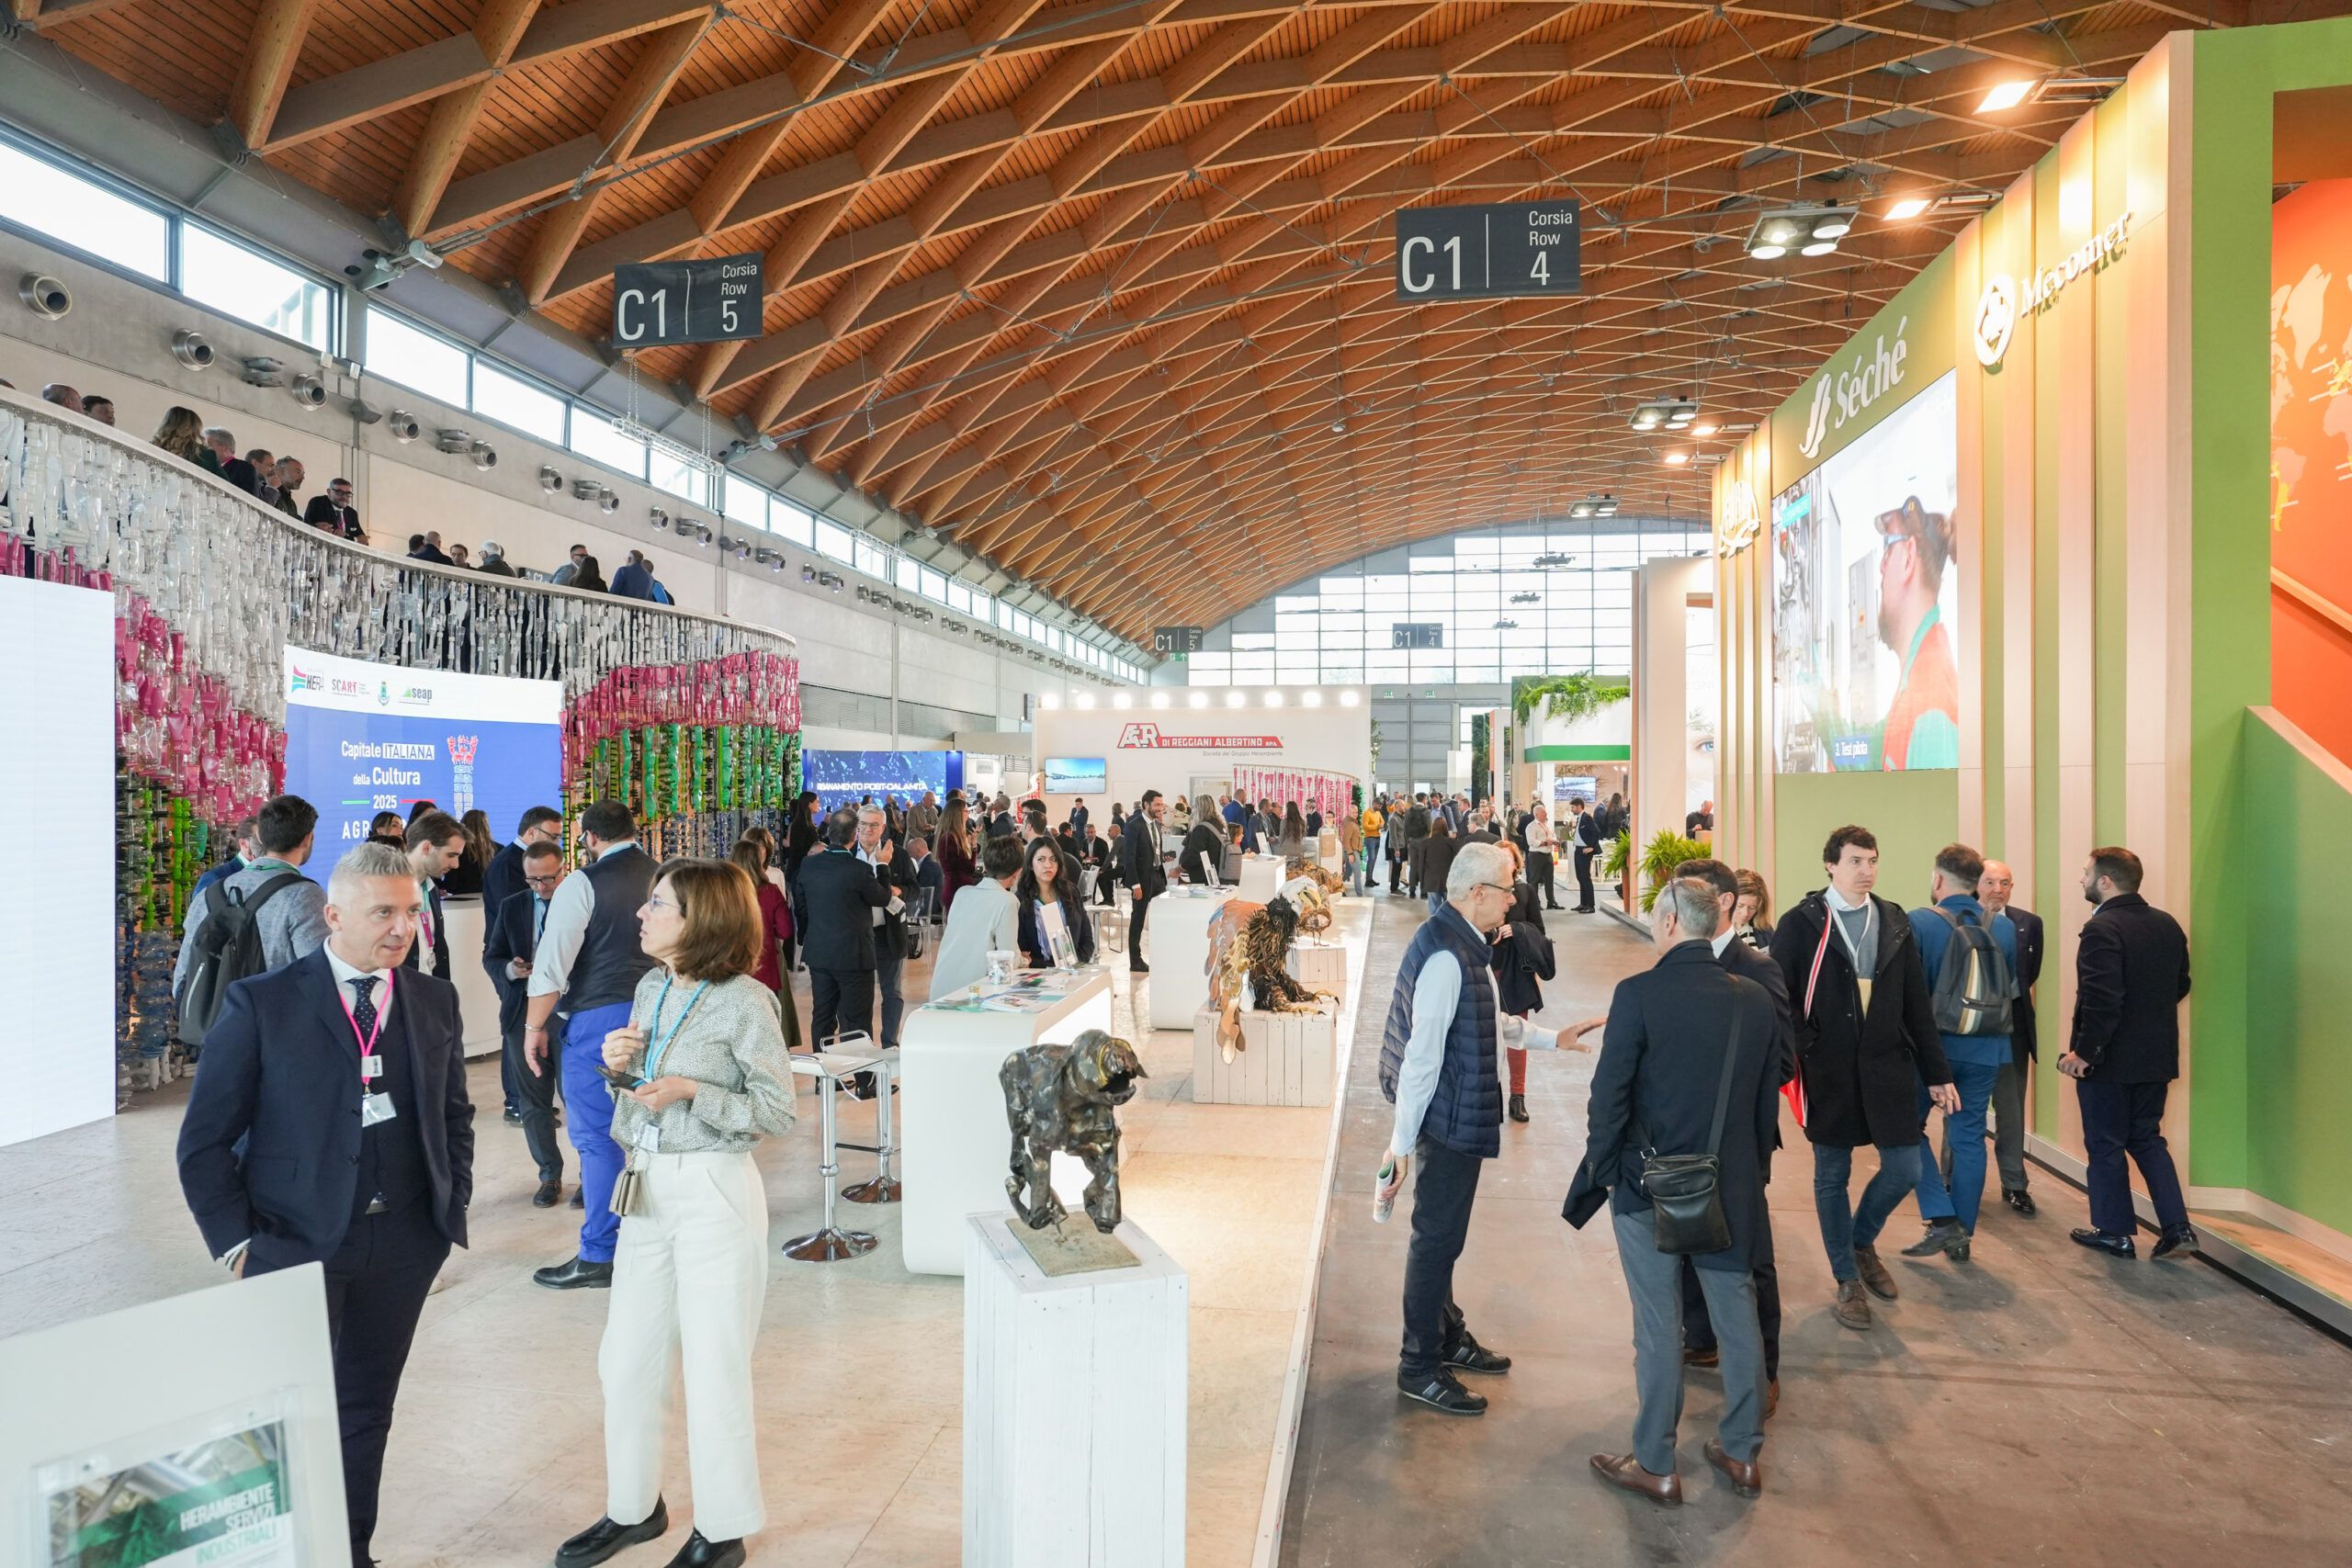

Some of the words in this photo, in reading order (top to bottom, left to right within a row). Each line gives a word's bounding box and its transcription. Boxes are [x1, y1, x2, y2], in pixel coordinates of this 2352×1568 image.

[1529, 209, 1573, 226] Corsia
[1529, 231, 1561, 246] Row
[722, 262, 757, 278] Corsia
[1402, 236, 1461, 293] C1
[1530, 251, 1550, 286] 4
[2020, 210, 2132, 318] Mecomer
[721, 282, 747, 296] Row
[618, 288, 666, 341] C1
[722, 300, 738, 333] 5
[1835, 315, 1907, 429] Séché
[1155, 634, 1172, 651] C1
[1189, 640, 1195, 650] 5
[1393, 630, 1410, 648] C1
[1429, 637, 1434, 648] 4
[332, 679, 357, 694] SCART
[412, 687, 433, 703] seap
[341, 740, 381, 761] Capitale
[384, 744, 434, 760] ITALIANA
[1162, 738, 1170, 747] DI
[1171, 738, 1213, 747] REGGIANI
[1215, 738, 1261, 747] ALBERTINO
[353, 774, 370, 785] della
[372, 766, 421, 785] Cultura
[373, 795, 397, 809] 2025
[180, 1481, 275, 1532] HERAMBIENTE
[225, 1501, 277, 1534] SERVIZI
